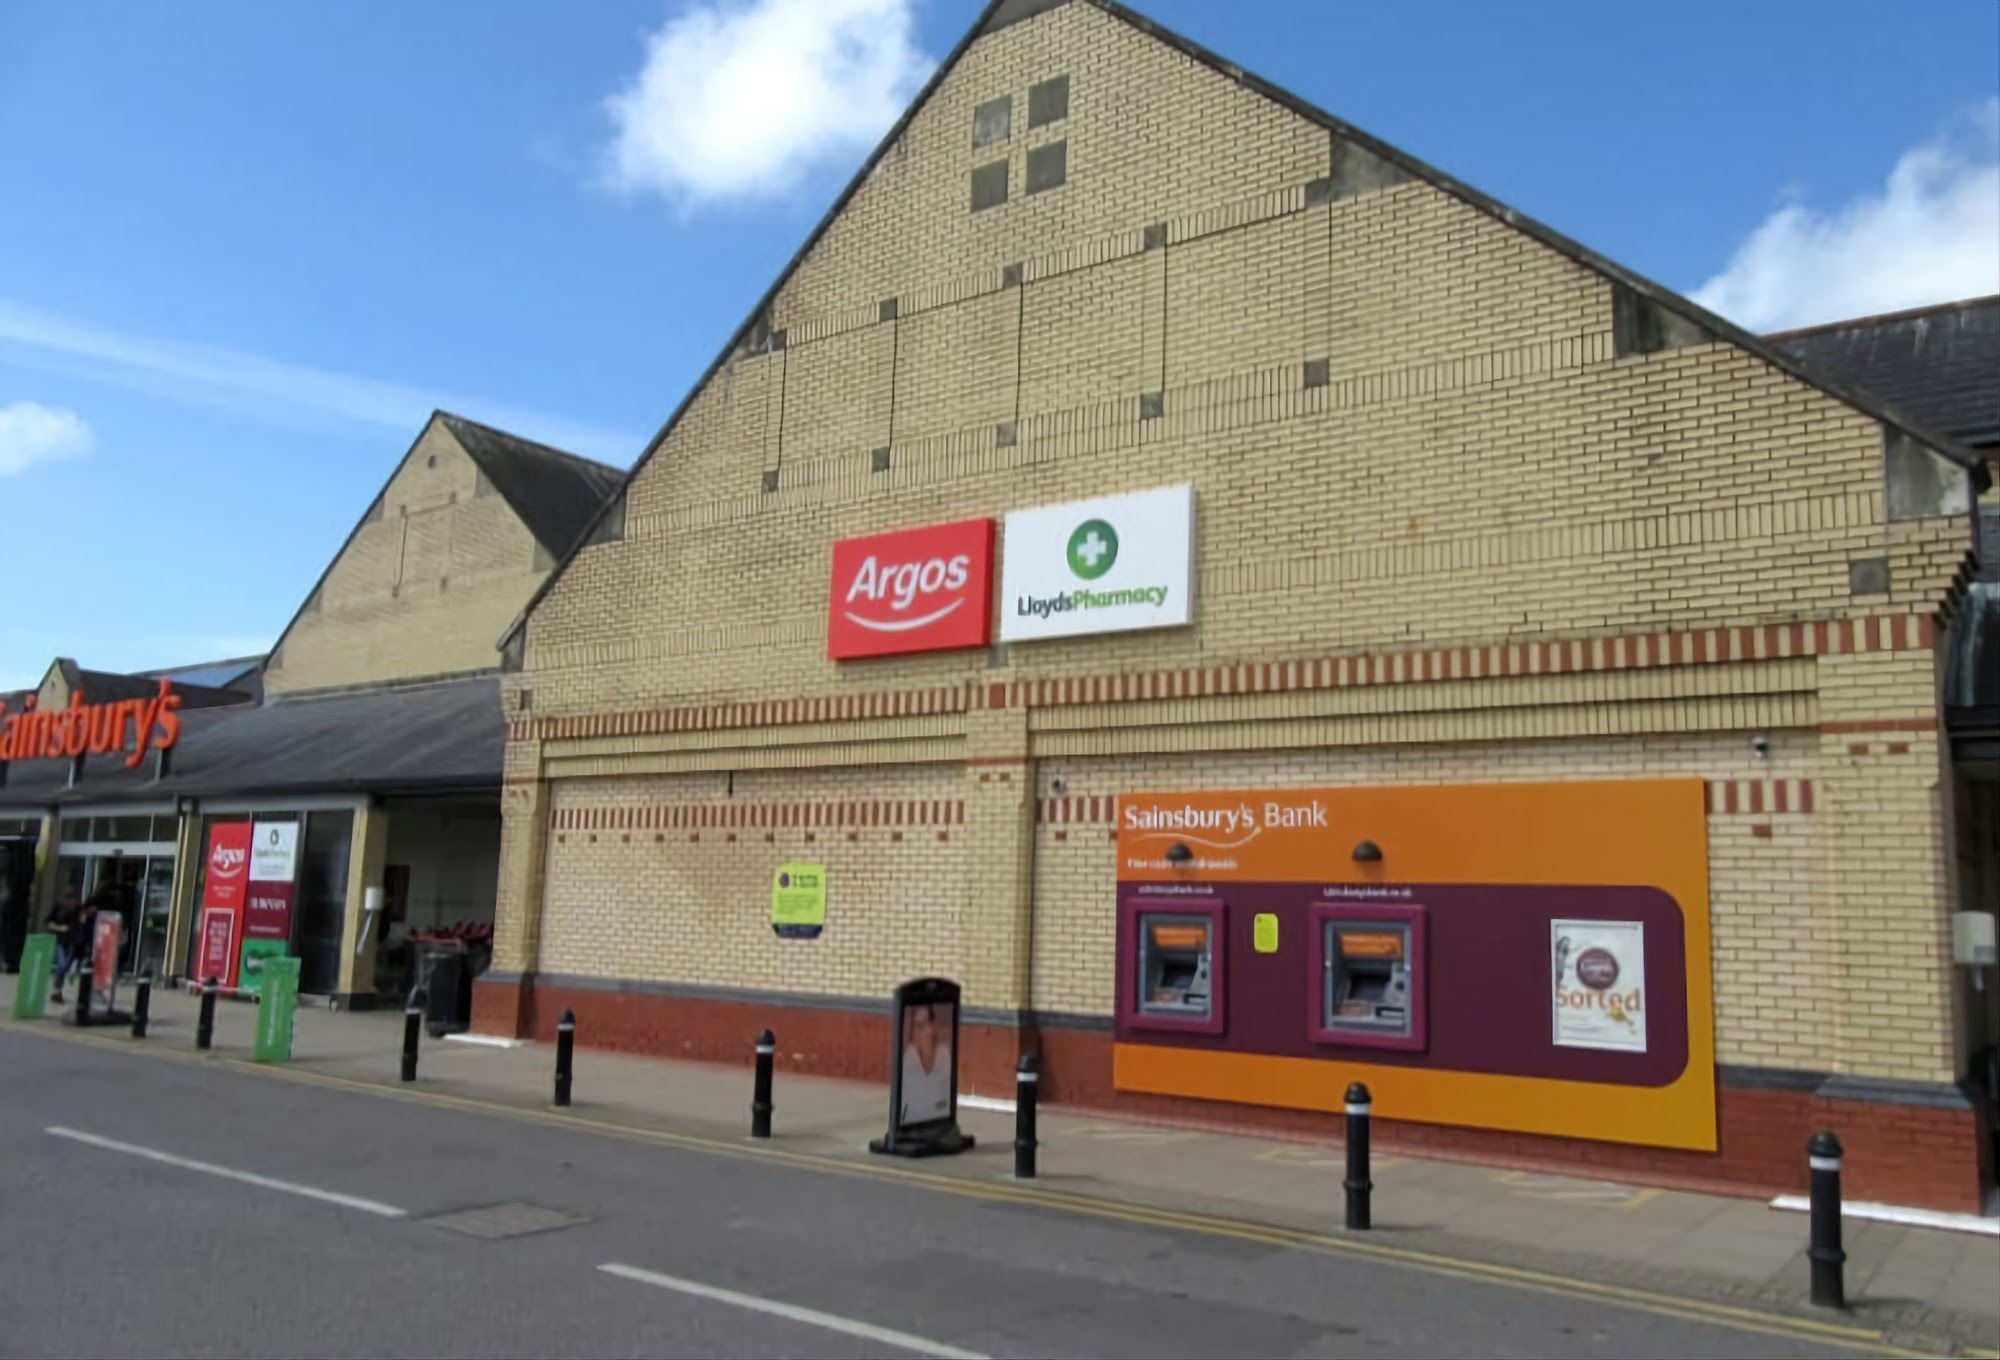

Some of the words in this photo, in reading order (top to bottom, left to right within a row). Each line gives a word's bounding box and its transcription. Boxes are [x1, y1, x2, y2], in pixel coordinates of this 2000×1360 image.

[846, 555, 969, 611] Argos
[1017, 585, 1168, 619] LloydsPharmacy
[0, 678, 182, 769] ainsbury's
[1124, 802, 1254, 833] Sainsbury's
[1264, 800, 1329, 828] Bank
